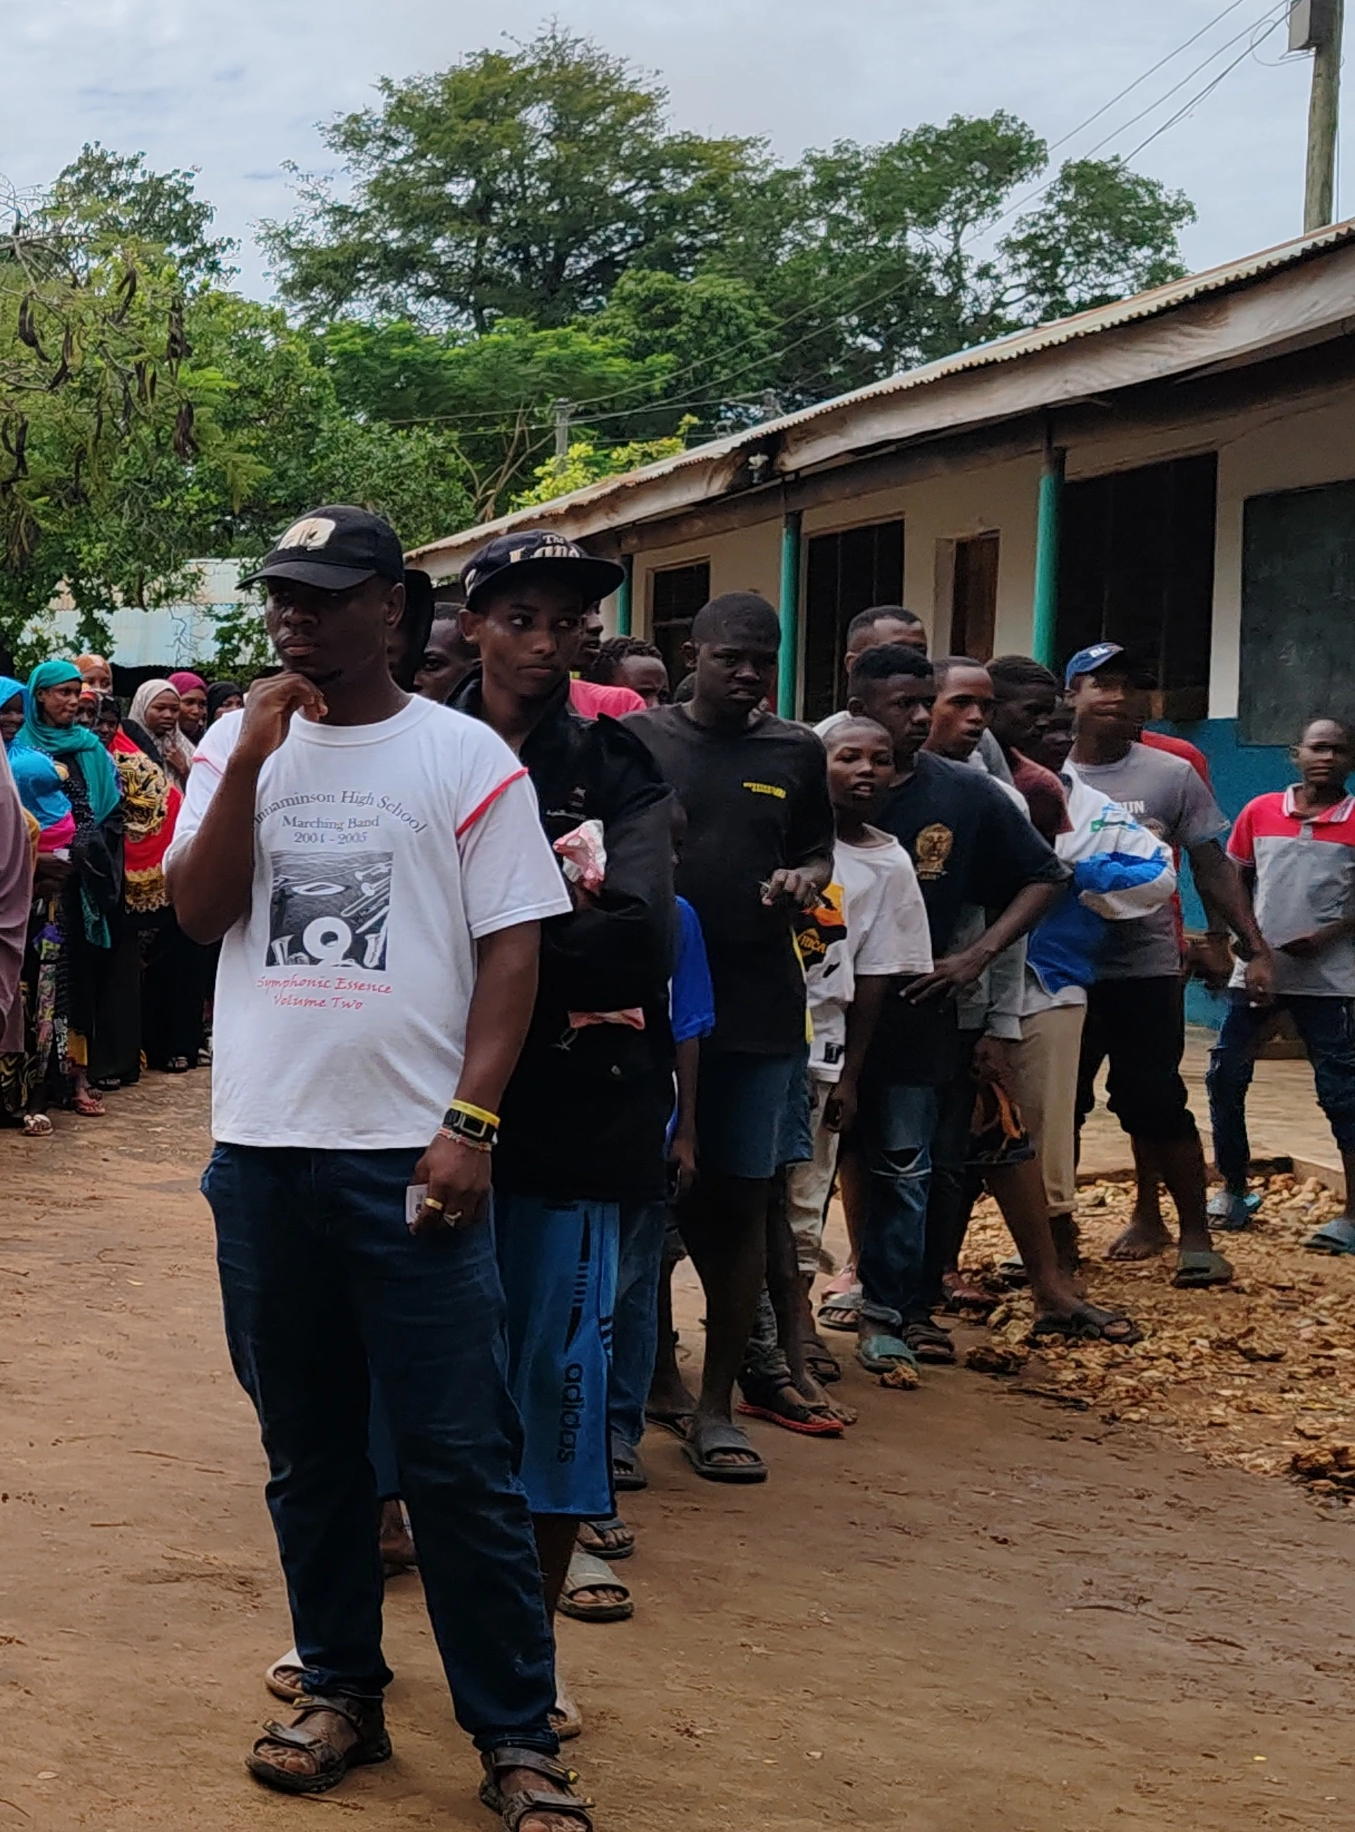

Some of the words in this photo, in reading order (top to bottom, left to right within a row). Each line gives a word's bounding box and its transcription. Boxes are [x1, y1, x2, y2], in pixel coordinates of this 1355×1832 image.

[254, 790, 336, 824] innaminson
[341, 790, 375, 807] High
[377, 795, 428, 834] School
[281, 814, 345, 831] Marching
[347, 815, 380, 829] Band
[337, 831, 368, 845] 2005
[257, 973, 331, 997] Symphonic
[334, 977, 393, 994] Essence
[273, 993, 327, 1008] Volume
[331, 997, 364, 1010] Two
[556, 1363, 585, 1462] adidas
